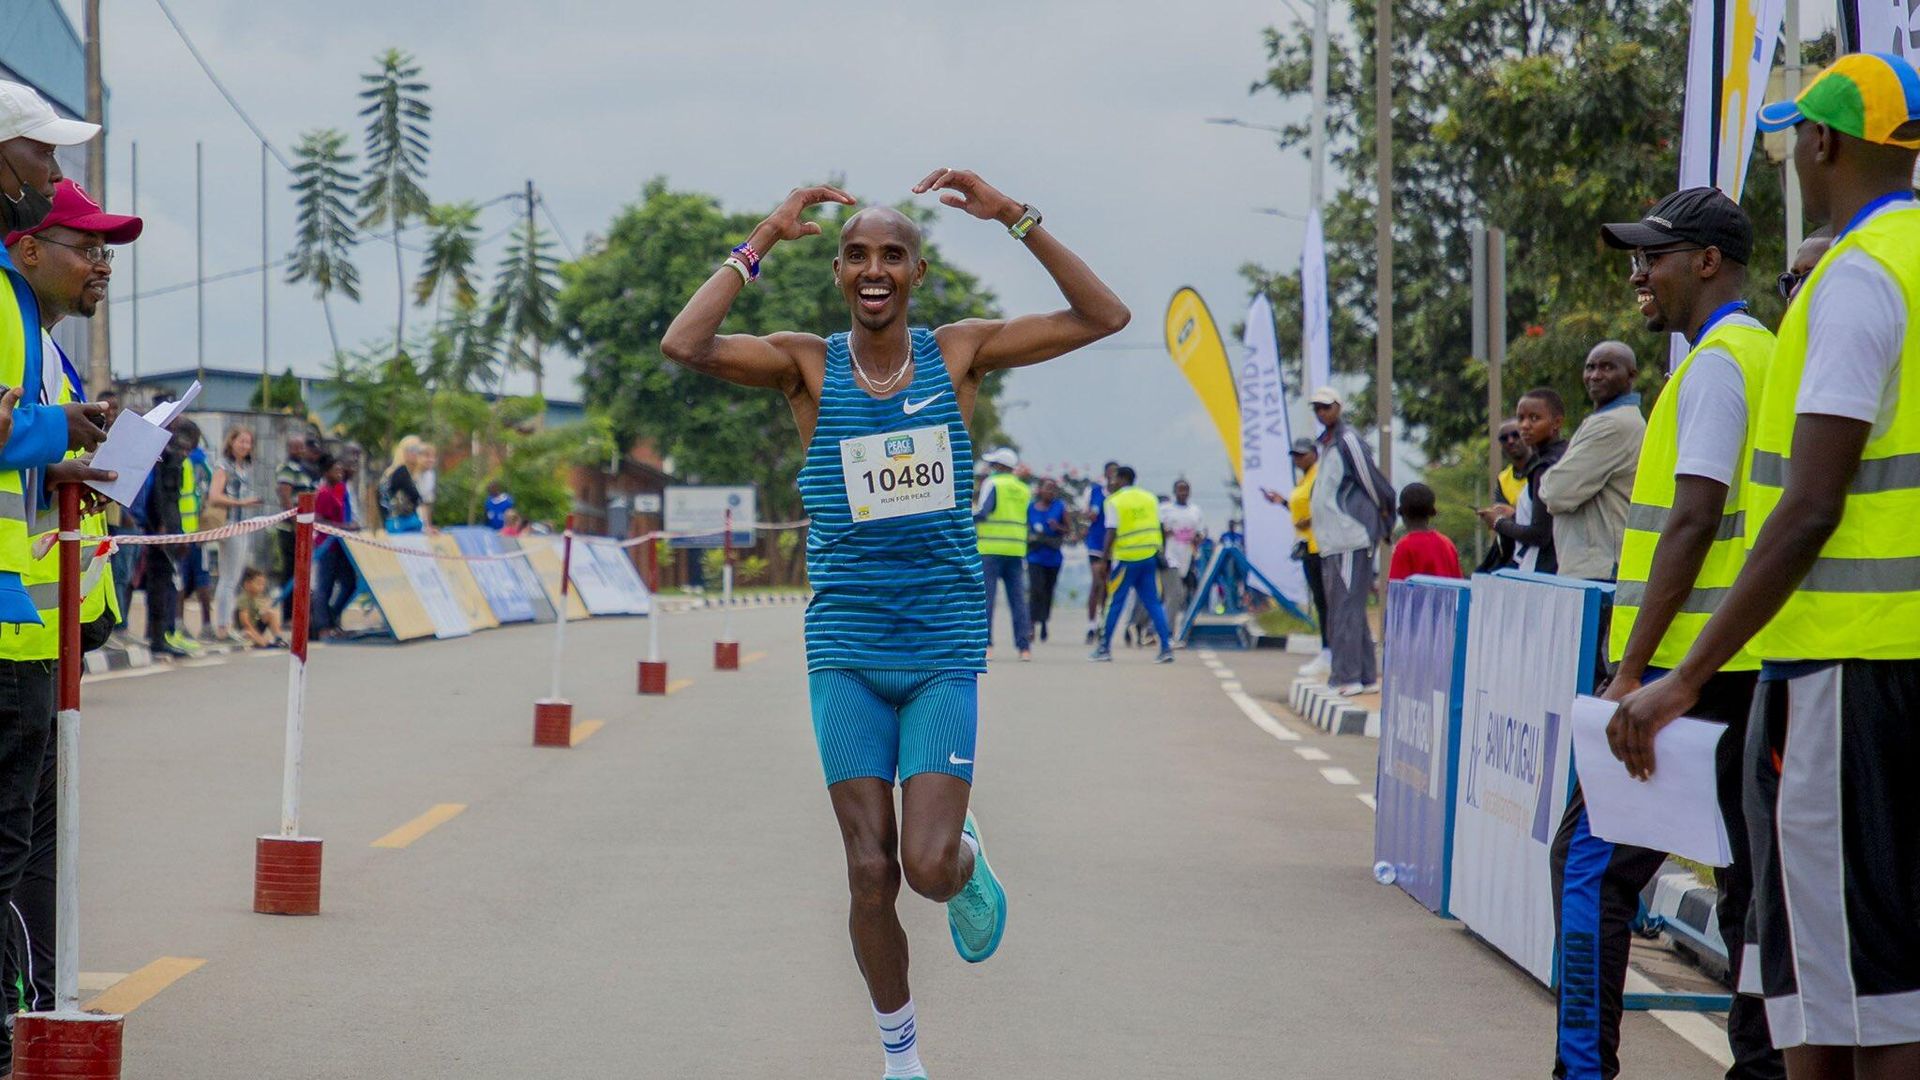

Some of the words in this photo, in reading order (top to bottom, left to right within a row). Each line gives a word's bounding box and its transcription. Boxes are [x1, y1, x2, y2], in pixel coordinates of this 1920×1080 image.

[887, 440, 911, 449] PEACE
[862, 461, 944, 493] 10480
[911, 492, 930, 500] PEACE
